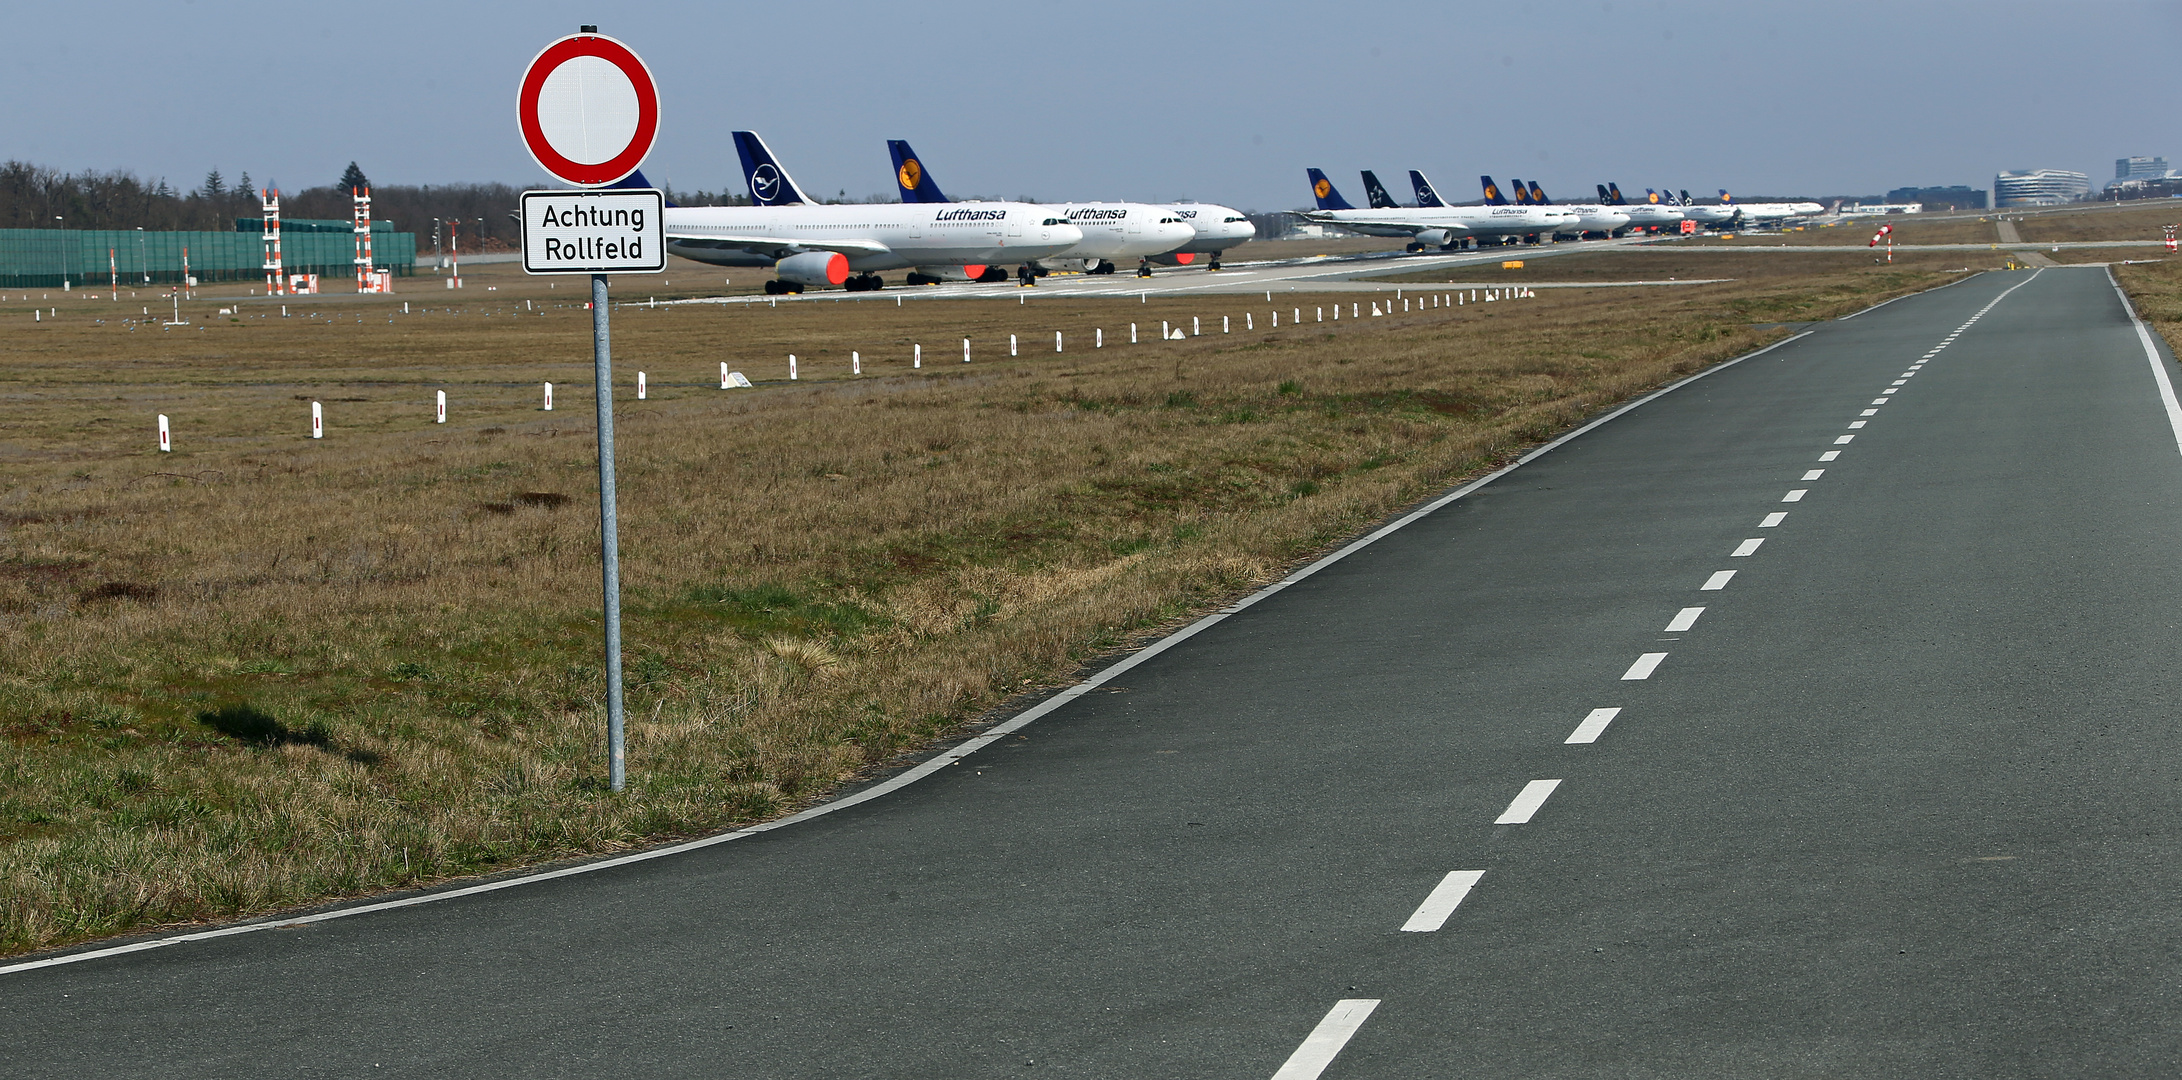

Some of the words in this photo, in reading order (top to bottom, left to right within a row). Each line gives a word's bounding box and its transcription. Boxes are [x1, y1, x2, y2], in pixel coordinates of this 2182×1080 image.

[542, 204, 644, 232] Achtung
[935, 208, 1007, 221] Lufthansa
[545, 236, 642, 261] Rollfeld
